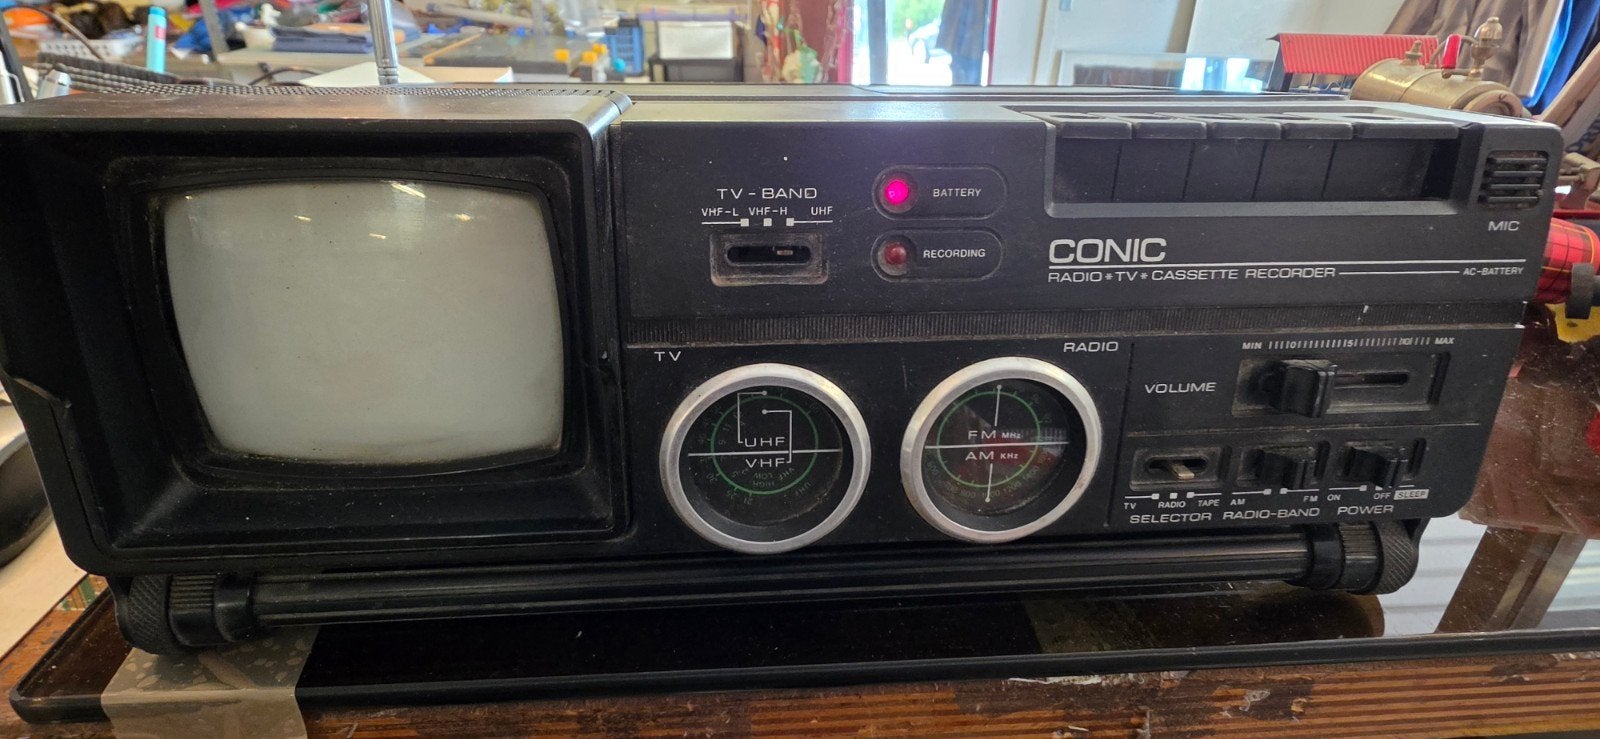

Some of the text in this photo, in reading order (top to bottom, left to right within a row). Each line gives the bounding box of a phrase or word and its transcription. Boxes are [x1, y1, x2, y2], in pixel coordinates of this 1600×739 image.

[933, 188, 981, 197] BATTERY
[702, 208, 738, 216] VHF-L
[749, 207, 787, 215] VHF-H
[811, 206, 832, 215] UHF
[1488, 221, 1519, 231] MIC
[924, 249, 985, 258] RECORDING
[1049, 238, 1166, 263] CONIC
[1245, 267, 1336, 278] RECORDER
[1463, 267, 1523, 275] AC-BATTERY
[1064, 342, 1118, 352] RADIO
[1242, 341, 1262, 350] MIN
[1434, 337, 1455, 345] MAX
[654, 352, 681, 361] TV
[1145, 382, 1216, 393] VOLUME
[968, 430, 996, 439] FM
[745, 437, 784, 447] UHF
[966, 451, 994, 460] AM
[746, 458, 784, 467] VHF
[1373, 492, 1391, 500] OFF
[1398, 490, 1427, 499] SLEEP
[1158, 501, 1186, 509] RADIO
[1338, 505, 1394, 514] POWER
[1130, 513, 1212, 523] SELECTOR
[1223, 508, 1320, 519] RADIO-BAND
